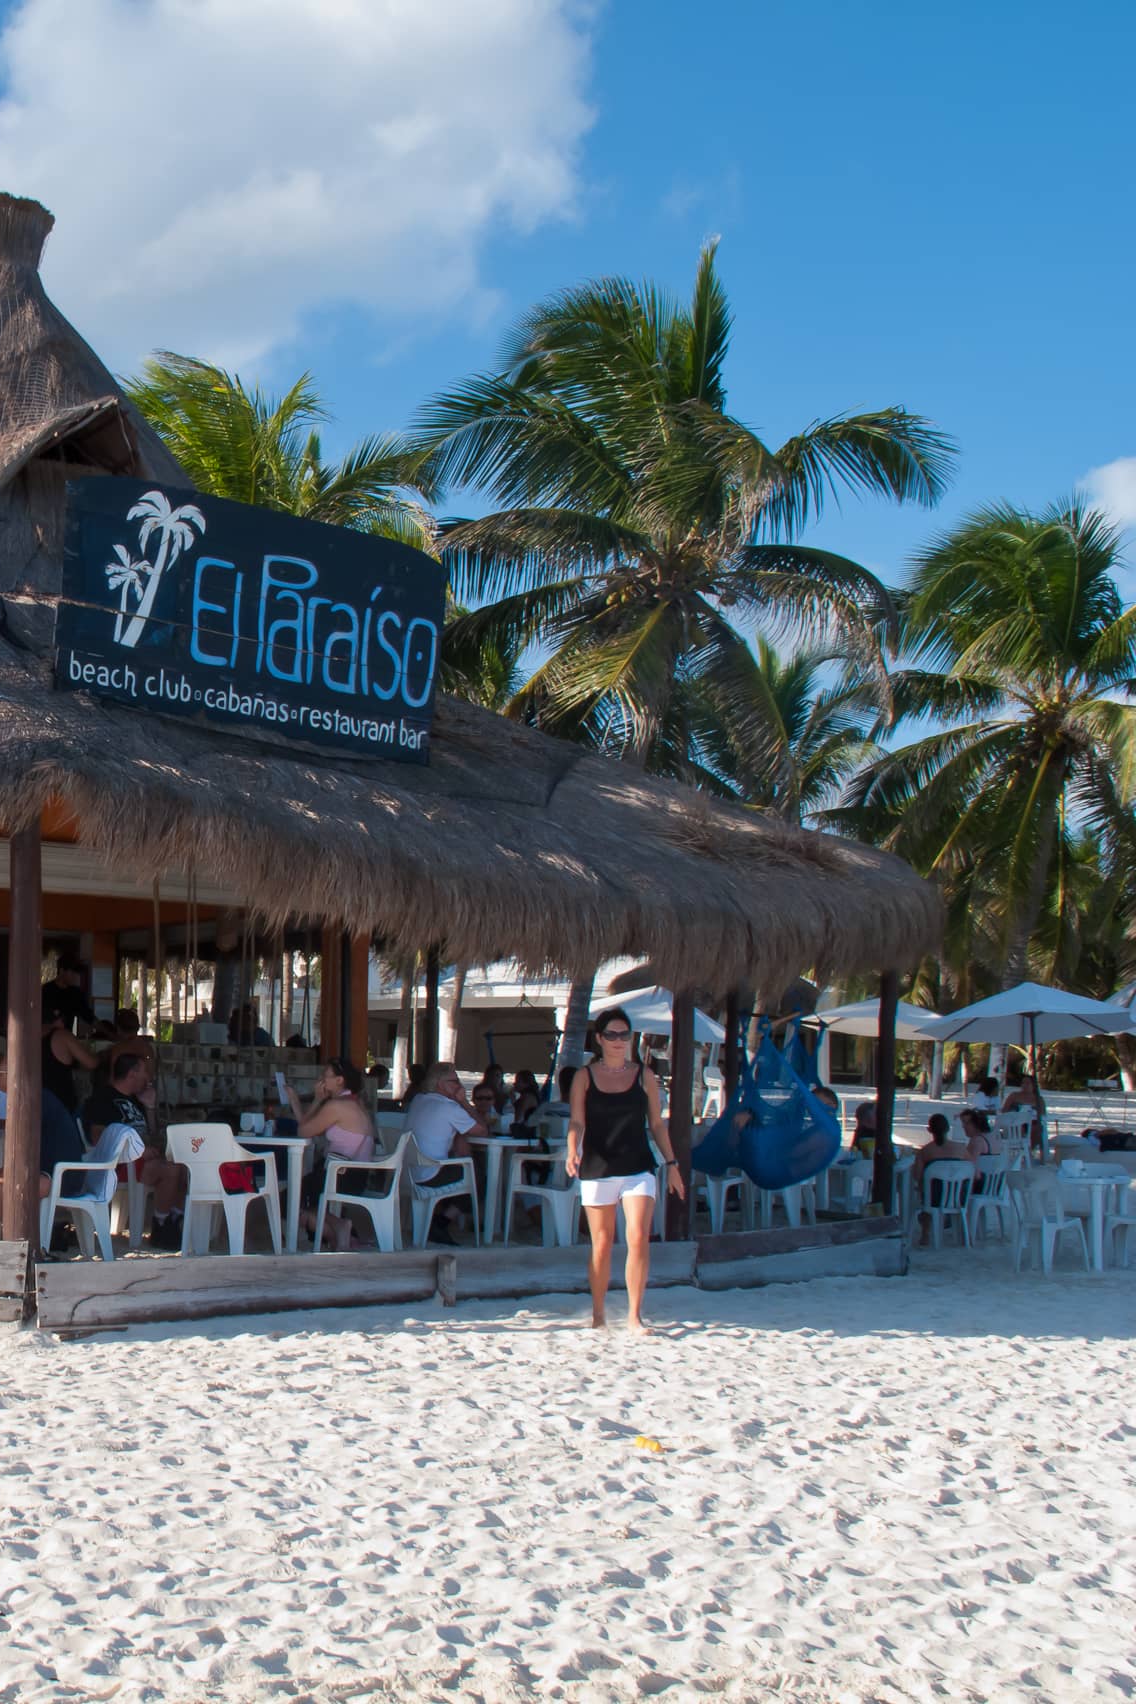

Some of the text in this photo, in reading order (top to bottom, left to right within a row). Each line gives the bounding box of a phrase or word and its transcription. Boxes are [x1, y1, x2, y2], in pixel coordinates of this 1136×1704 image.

[190, 555, 437, 707] El Paraíso
[69, 650, 427, 750] beach club cabañas restaurant bar
